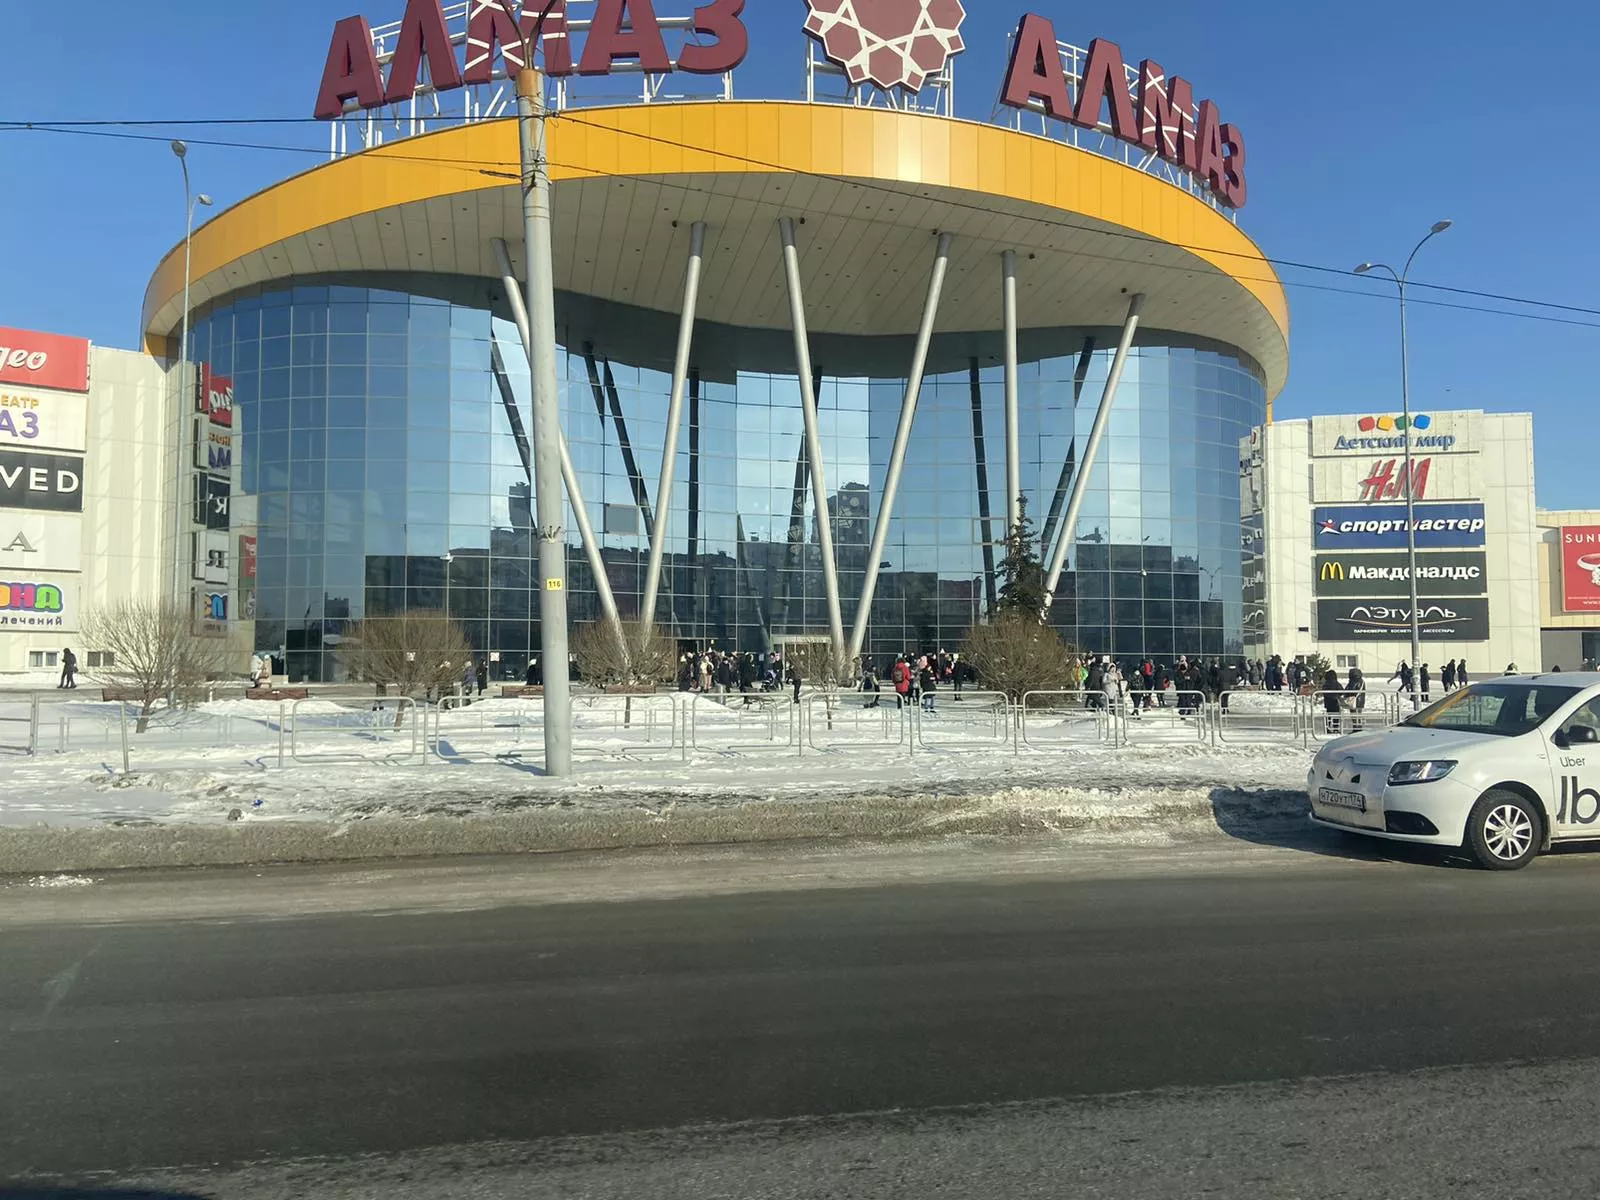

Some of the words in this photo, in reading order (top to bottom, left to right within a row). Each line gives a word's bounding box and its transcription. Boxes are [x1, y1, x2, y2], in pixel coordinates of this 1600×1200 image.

[314, 0, 748, 120] АЛМАЗ
[1000, 12, 1246, 209] АЛМАЗ
[1416, 434, 1455, 450] мир
[0, 465, 79, 493] VED
[1359, 457, 1431, 501] H&M
[1340, 518, 1484, 533] спортмастер
[2, 531, 37, 552] A
[1560, 757, 1585, 767] Uber
